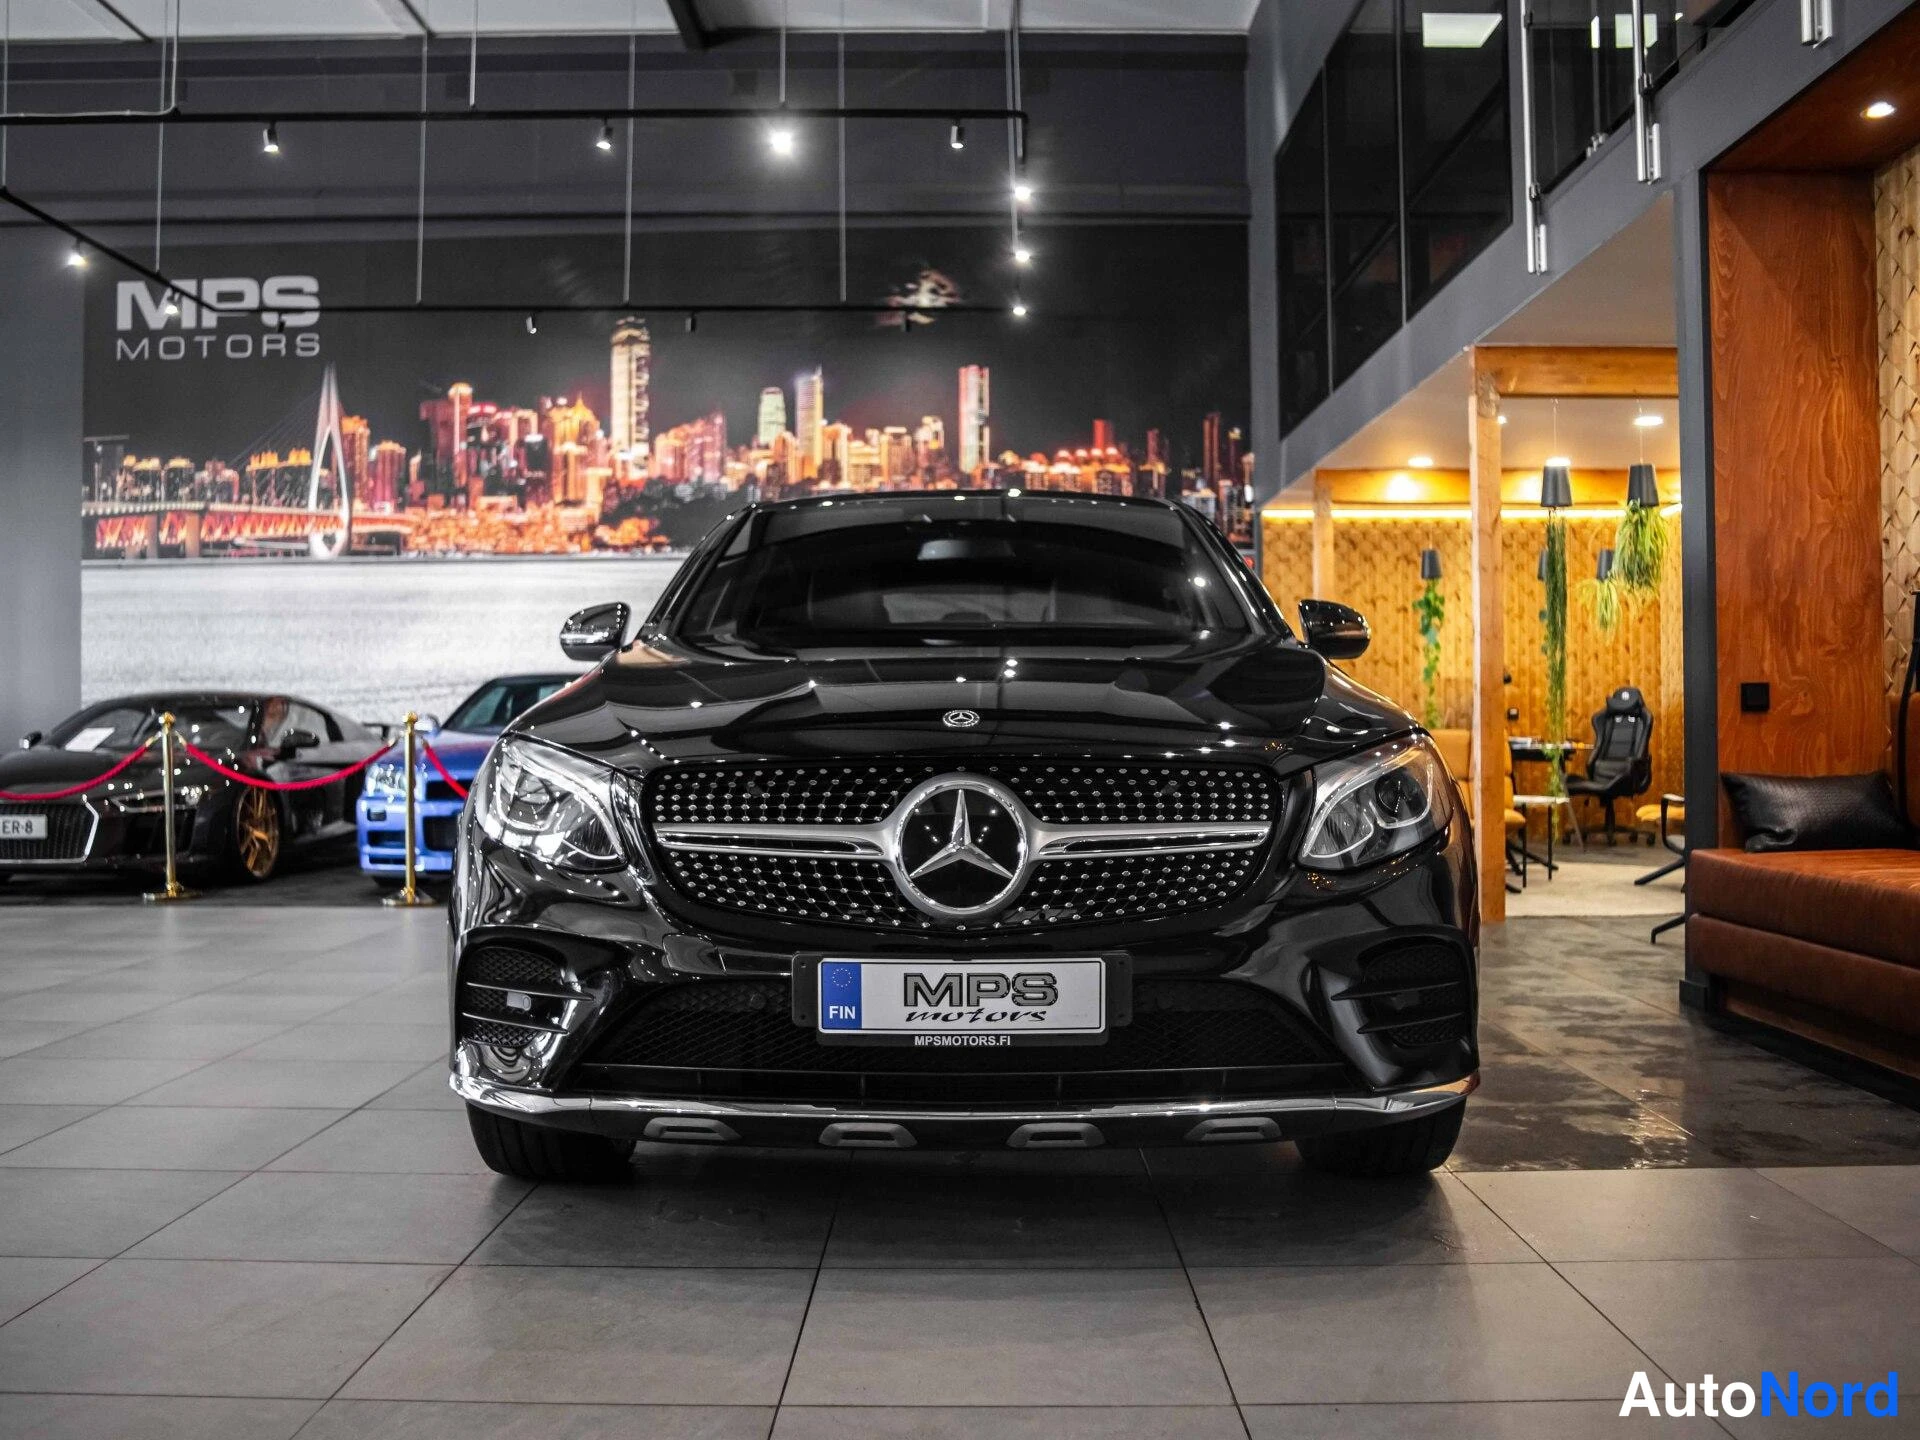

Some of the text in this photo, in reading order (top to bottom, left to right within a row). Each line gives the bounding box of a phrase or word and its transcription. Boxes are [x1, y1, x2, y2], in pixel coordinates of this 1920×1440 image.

[116, 275, 320, 331] MPS
[116, 332, 320, 361] MOTORS
[903, 971, 1059, 1007] MPS
[829, 1005, 856, 1020] FIN
[904, 1007, 1047, 1024] motors
[914, 1034, 1011, 1047] MPSMOTORS.FI
